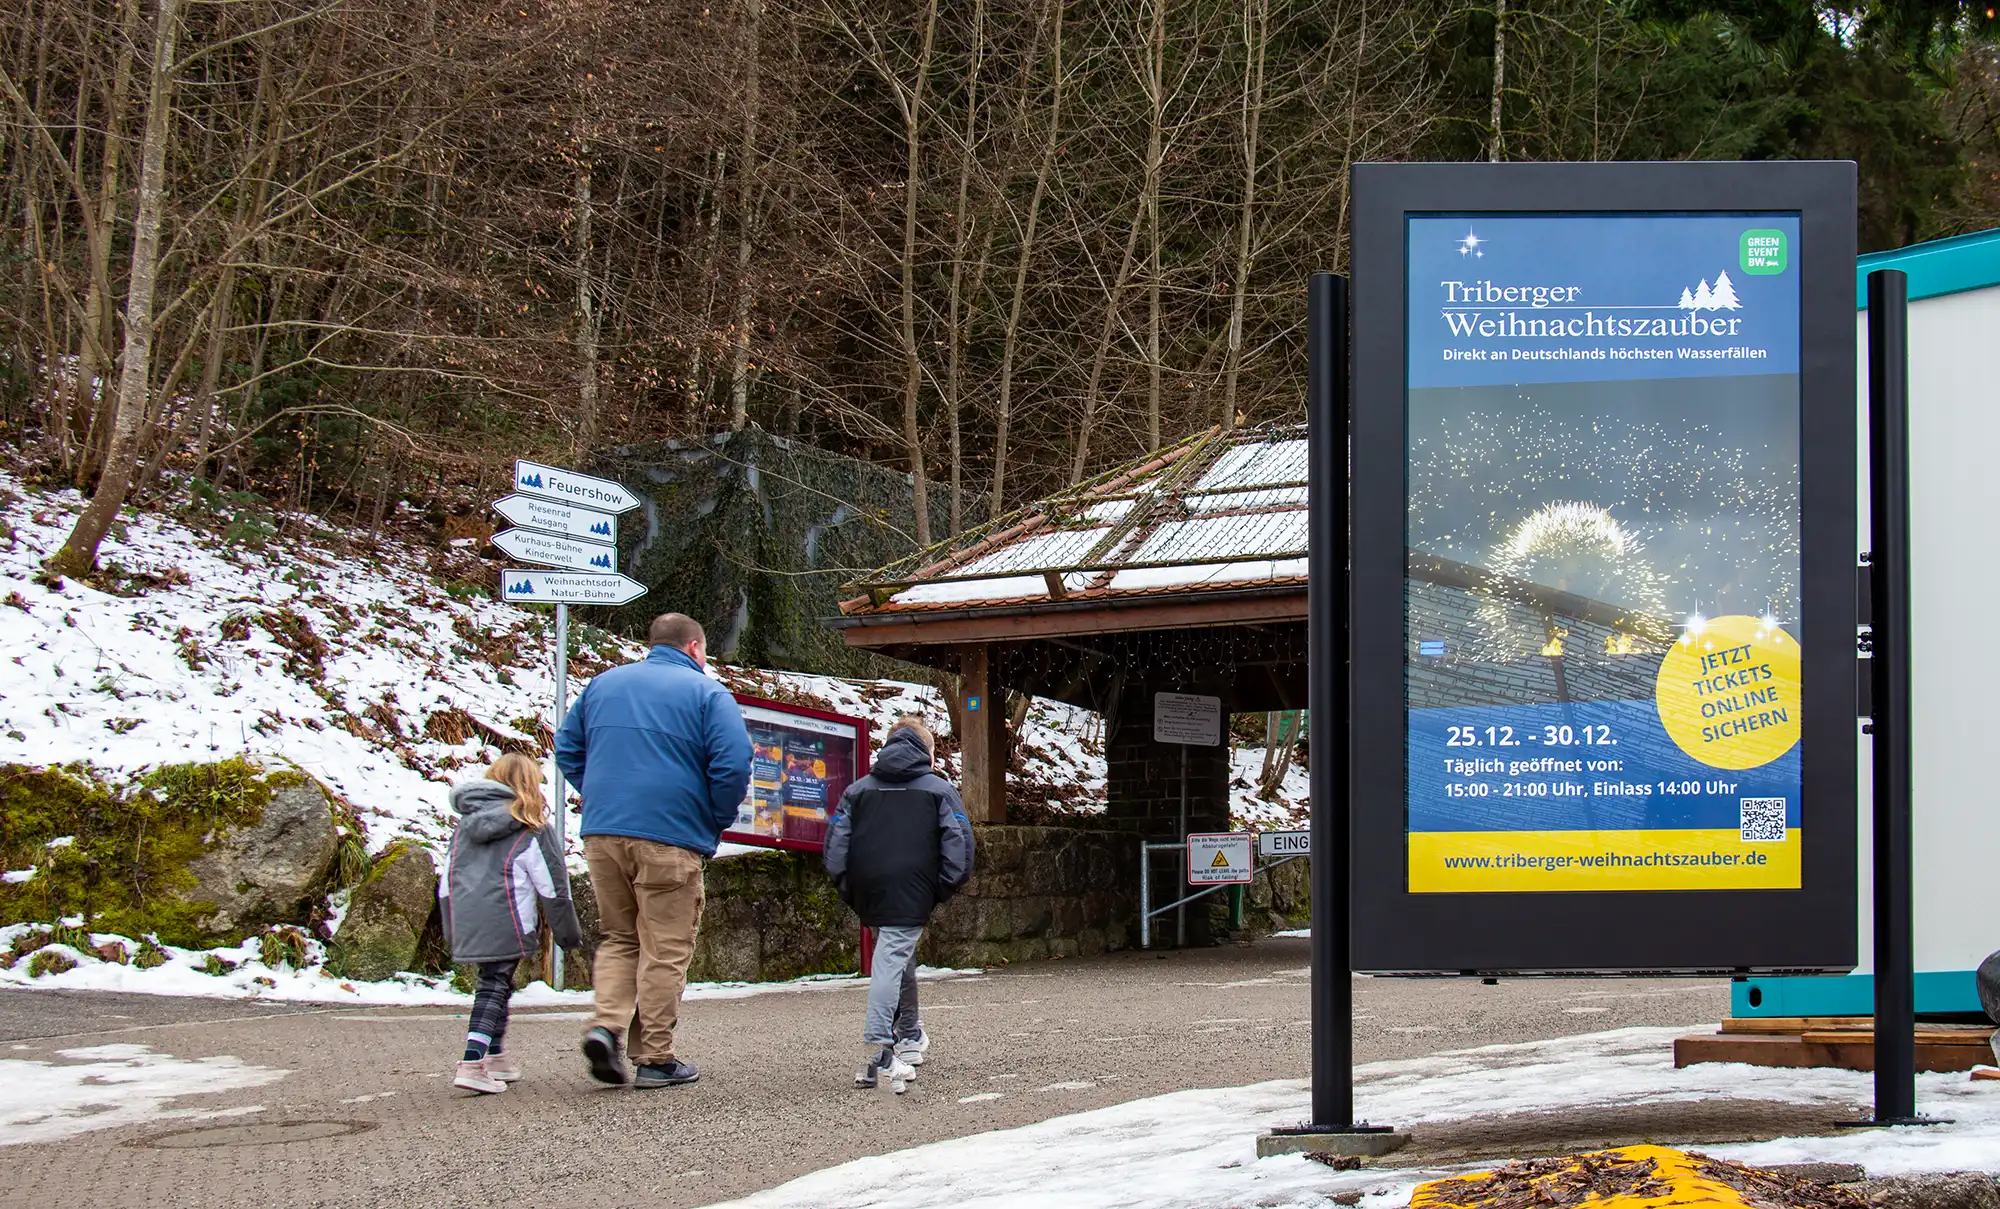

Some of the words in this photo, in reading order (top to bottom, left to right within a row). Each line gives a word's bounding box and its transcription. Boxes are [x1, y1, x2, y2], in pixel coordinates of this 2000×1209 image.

[1748, 237, 1779, 247] GREEN
[1748, 247, 1779, 257] EVENT
[1748, 257, 1765, 267] BW
[1440, 281, 1580, 307] Triberger
[1444, 311, 1742, 338] Weihnachtszauber
[1443, 348, 1487, 361] Direkt
[1491, 351, 1508, 361] an
[1512, 347, 1606, 361] Deutschlands
[1610, 347, 1674, 360] höchsten
[1677, 347, 1767, 360] Wasserfällen
[549, 477, 622, 504] Feuershow
[528, 502, 571, 519] Riesenrad
[531, 515, 568, 531] Ausgang
[514, 533, 583, 554] Kurhaus-Bühne
[525, 548, 572, 563] Kinderwelt
[544, 576, 621, 588] Weihnachtsdorf
[551, 588, 616, 599] Natur-Bühne
[1700, 644, 1753, 676] JETZT
[1693, 664, 1774, 697] TICKETS
[1700, 686, 1779, 719] ONLINE
[1701, 708, 1789, 743] SICHERN
[1446, 726, 1521, 747] 25.12.
[1543, 725, 1618, 746] 30.12.
[1444, 758, 1505, 776] Täglich
[1509, 757, 1583, 776] geöffnet
[1586, 759, 1624, 772] von:
[1445, 783, 1489, 797] 15:00
[1503, 782, 1547, 797] 21:00
[1552, 781, 1589, 799] Uhr,
[1593, 781, 1652, 796] Einlass
[1657, 781, 1701, 796] 14:00
[1705, 780, 1738, 796] Uhr
[1274, 836, 1310, 850] EING
[1444, 851, 1767, 871] www.triberger-weihnachtszauber.de
